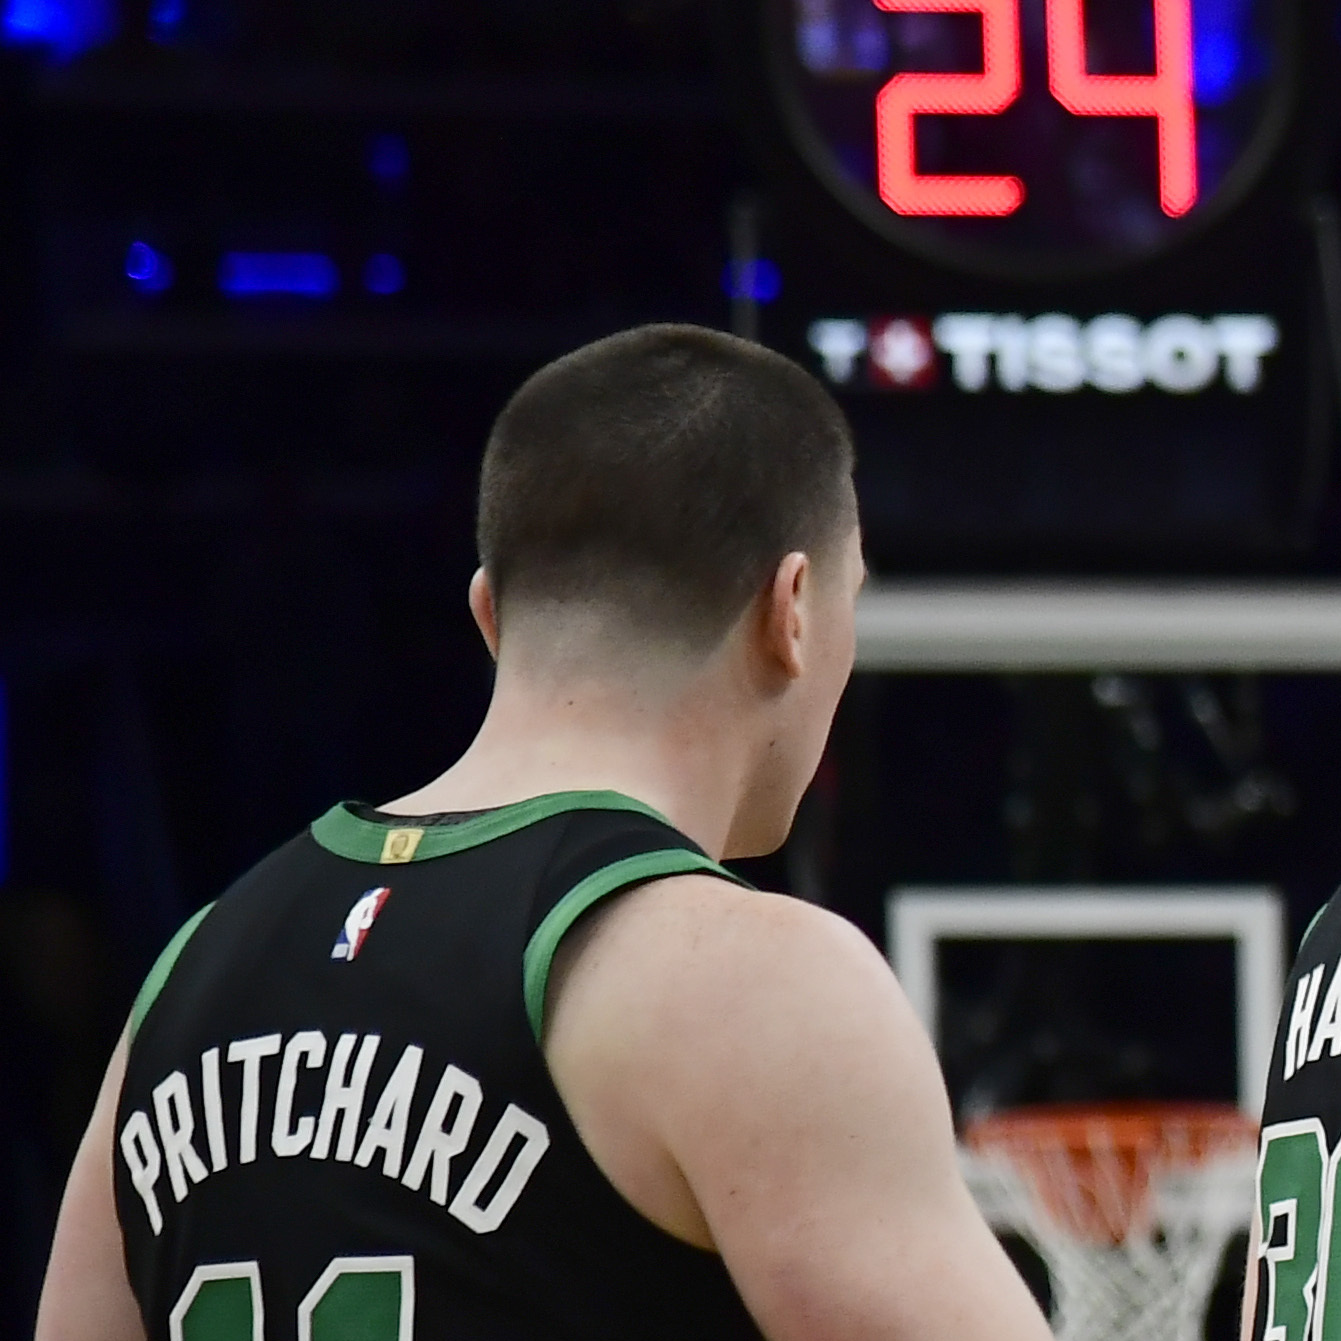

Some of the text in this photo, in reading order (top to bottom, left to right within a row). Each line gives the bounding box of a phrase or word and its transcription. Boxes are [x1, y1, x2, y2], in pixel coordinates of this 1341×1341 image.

[875, 0, 1198, 218] 24
[932, 311, 1280, 394] TISSOT
[119, 1030, 552, 1236] PRITCHARD
